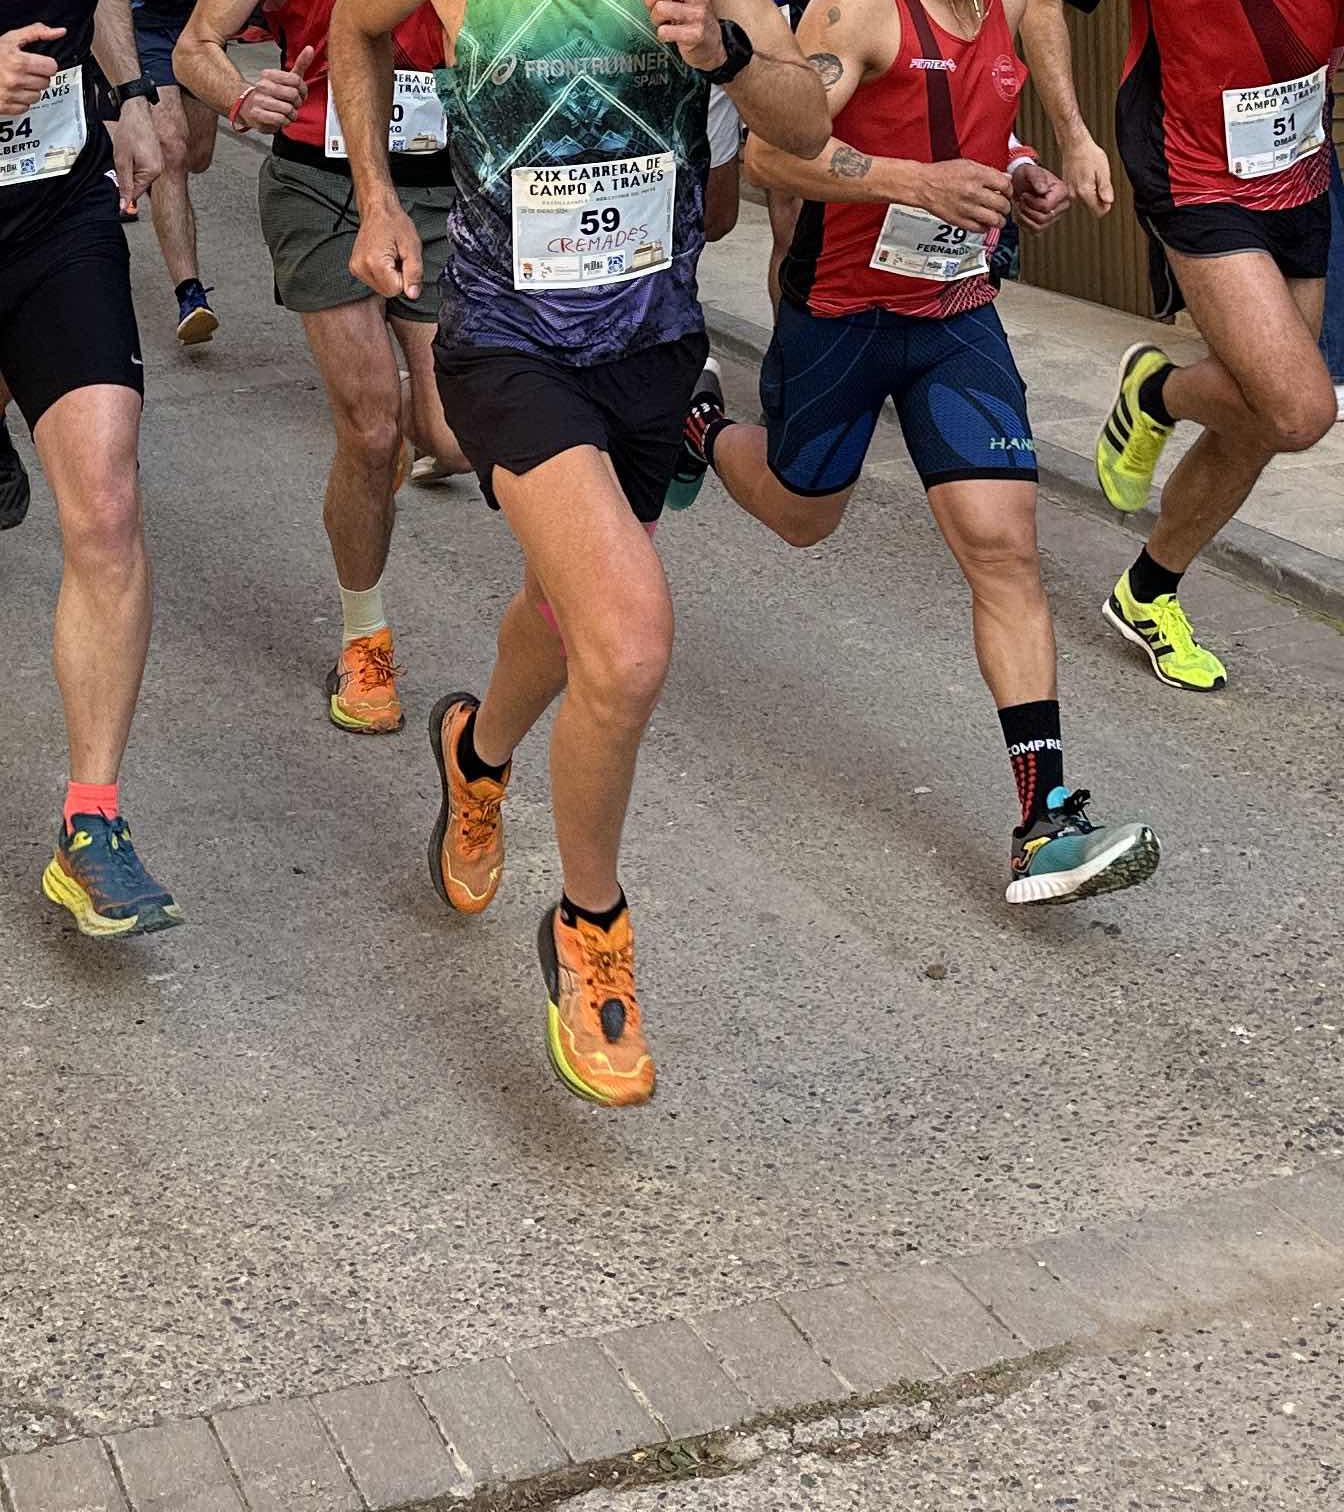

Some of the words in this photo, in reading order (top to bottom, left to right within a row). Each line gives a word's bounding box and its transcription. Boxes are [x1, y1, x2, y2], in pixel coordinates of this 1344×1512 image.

[524, 50, 669, 80] FRONTRUNNER
[633, 73, 669, 88] SPAIN
[1236, 98, 1277, 113] CAMPO
[1281, 96, 1290, 106] A
[1240, 91, 1260, 102] XIX
[1272, 113, 1296, 136] 51
[534, 170, 561, 182] XIX
[568, 162, 640, 181] CARRERA
[646, 157, 661, 169] DE
[529, 182, 587, 197] CAMPO
[593, 181, 605, 193] A
[612, 169, 664, 191] TRAVÉS
[580, 207, 620, 236] 59
[547, 224, 649, 254] CREMADES
[933, 224, 967, 245] 29
